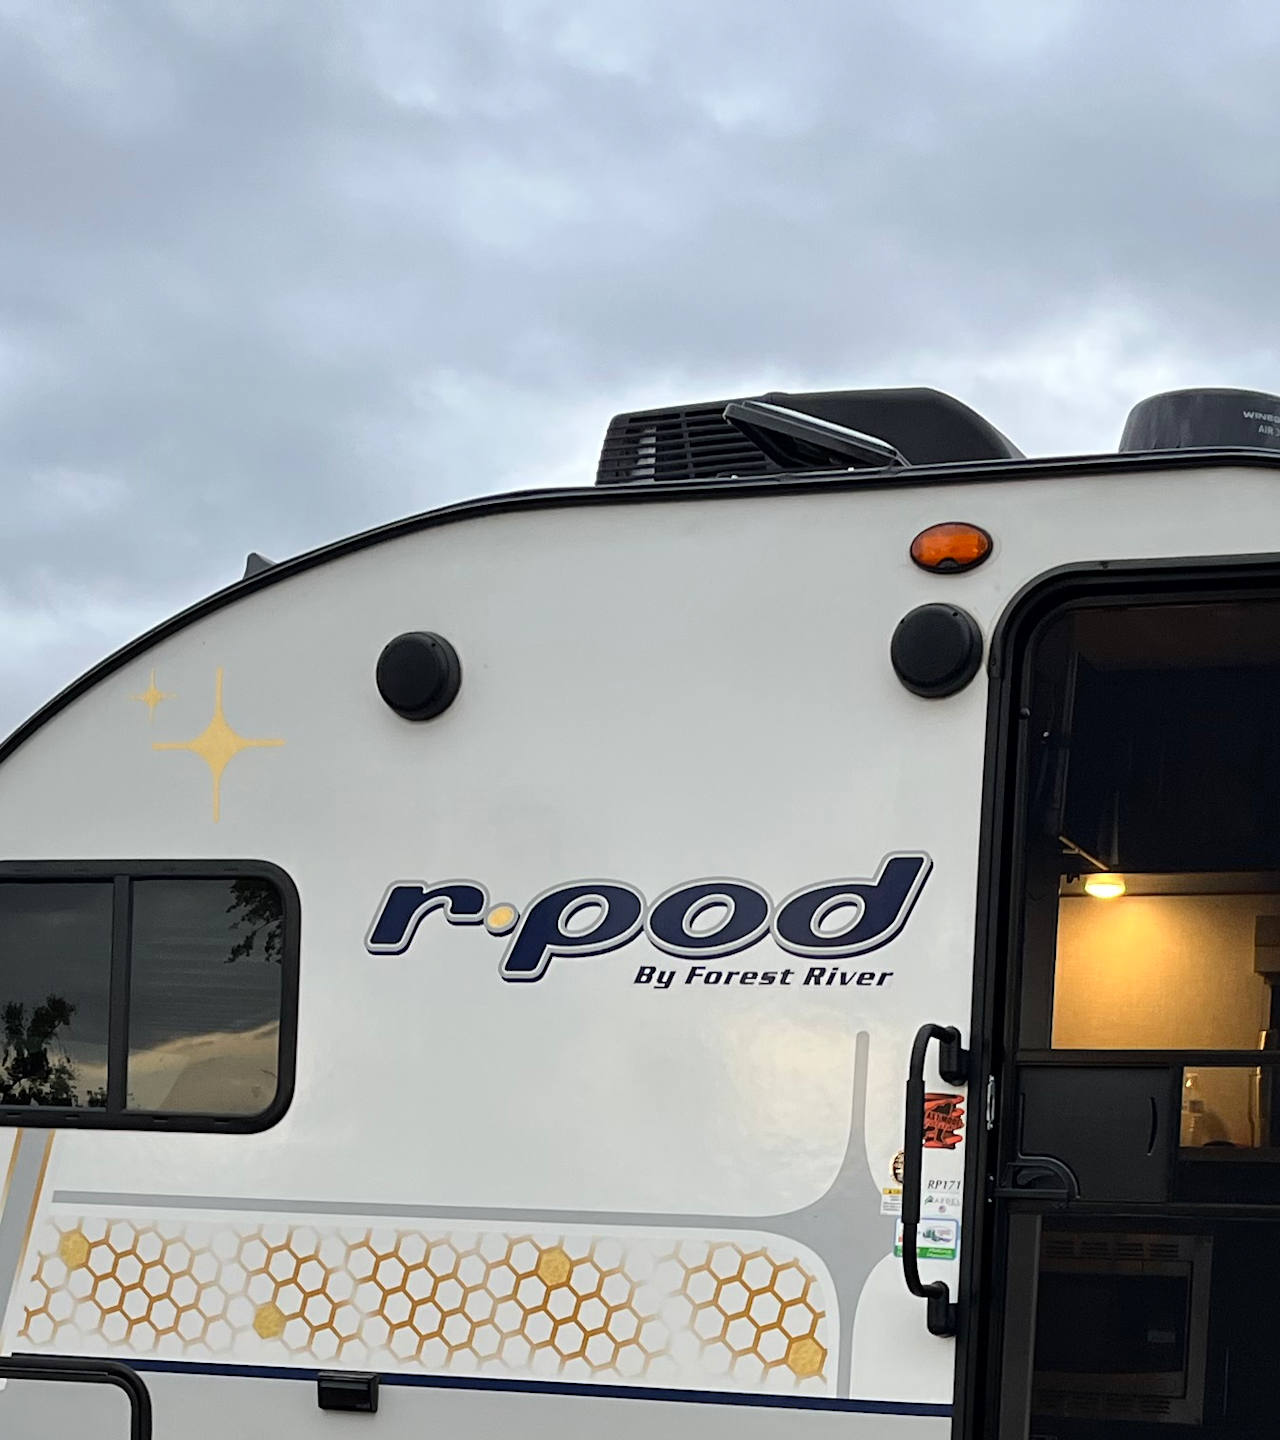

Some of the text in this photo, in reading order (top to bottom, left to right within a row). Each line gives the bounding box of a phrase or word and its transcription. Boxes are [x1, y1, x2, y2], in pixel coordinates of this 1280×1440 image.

[1258, 424, 1274, 438] AIR
[634, 966, 895, 989] By Forest River
